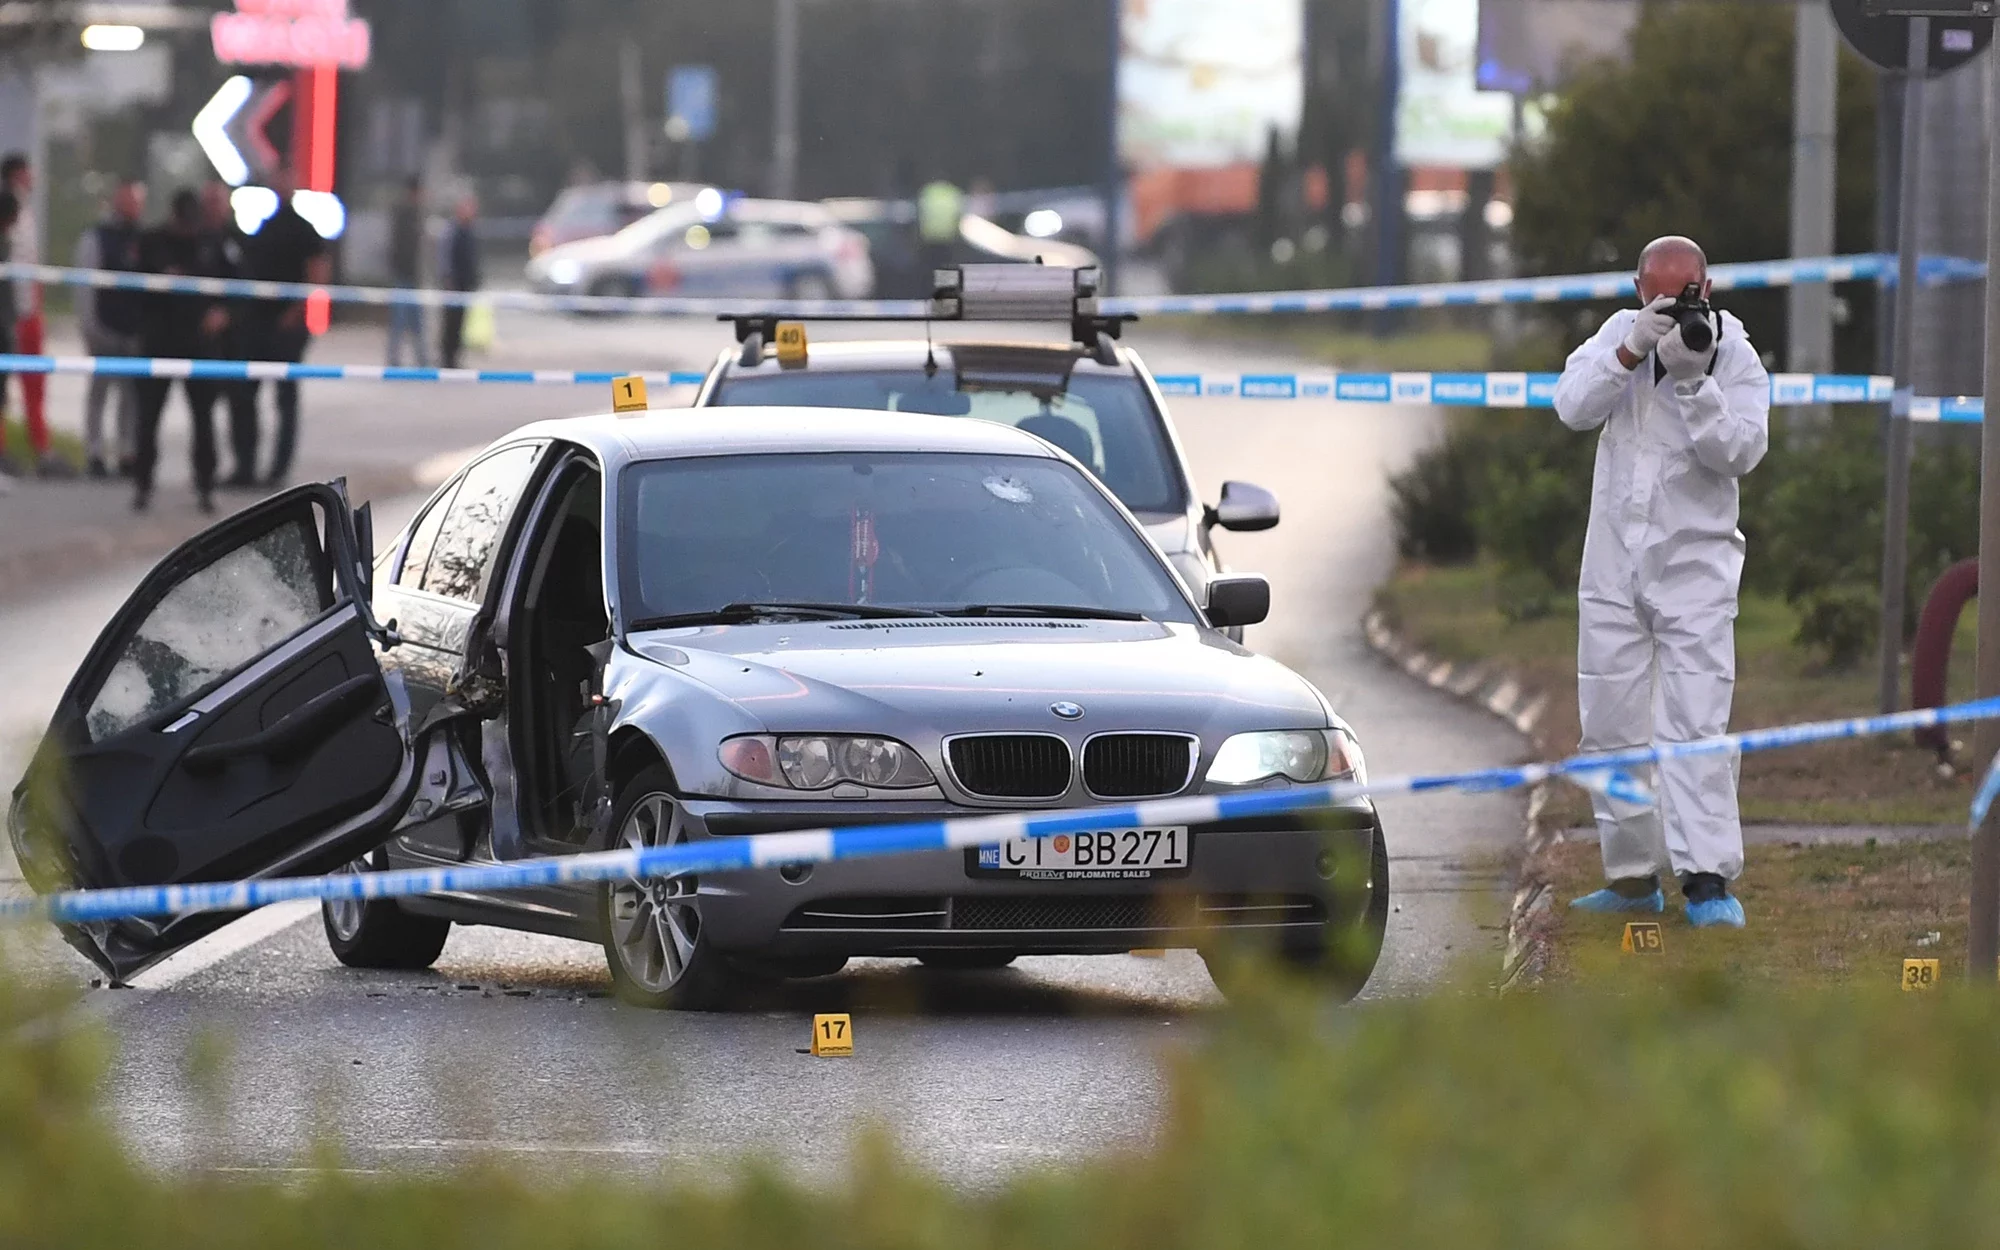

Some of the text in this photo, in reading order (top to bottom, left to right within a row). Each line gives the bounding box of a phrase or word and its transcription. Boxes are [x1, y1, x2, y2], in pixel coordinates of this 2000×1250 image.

[623, 382, 632, 398] 1
[1006, 829, 1182, 865] CT BB271
[979, 849, 999, 864] MNE
[1066, 870, 1120, 879] DIPLOMATIC
[1122, 870, 1151, 878] SALES
[1635, 930, 1659, 948] 15
[1907, 966, 1932, 984] 38
[821, 1021, 846, 1039] 17
